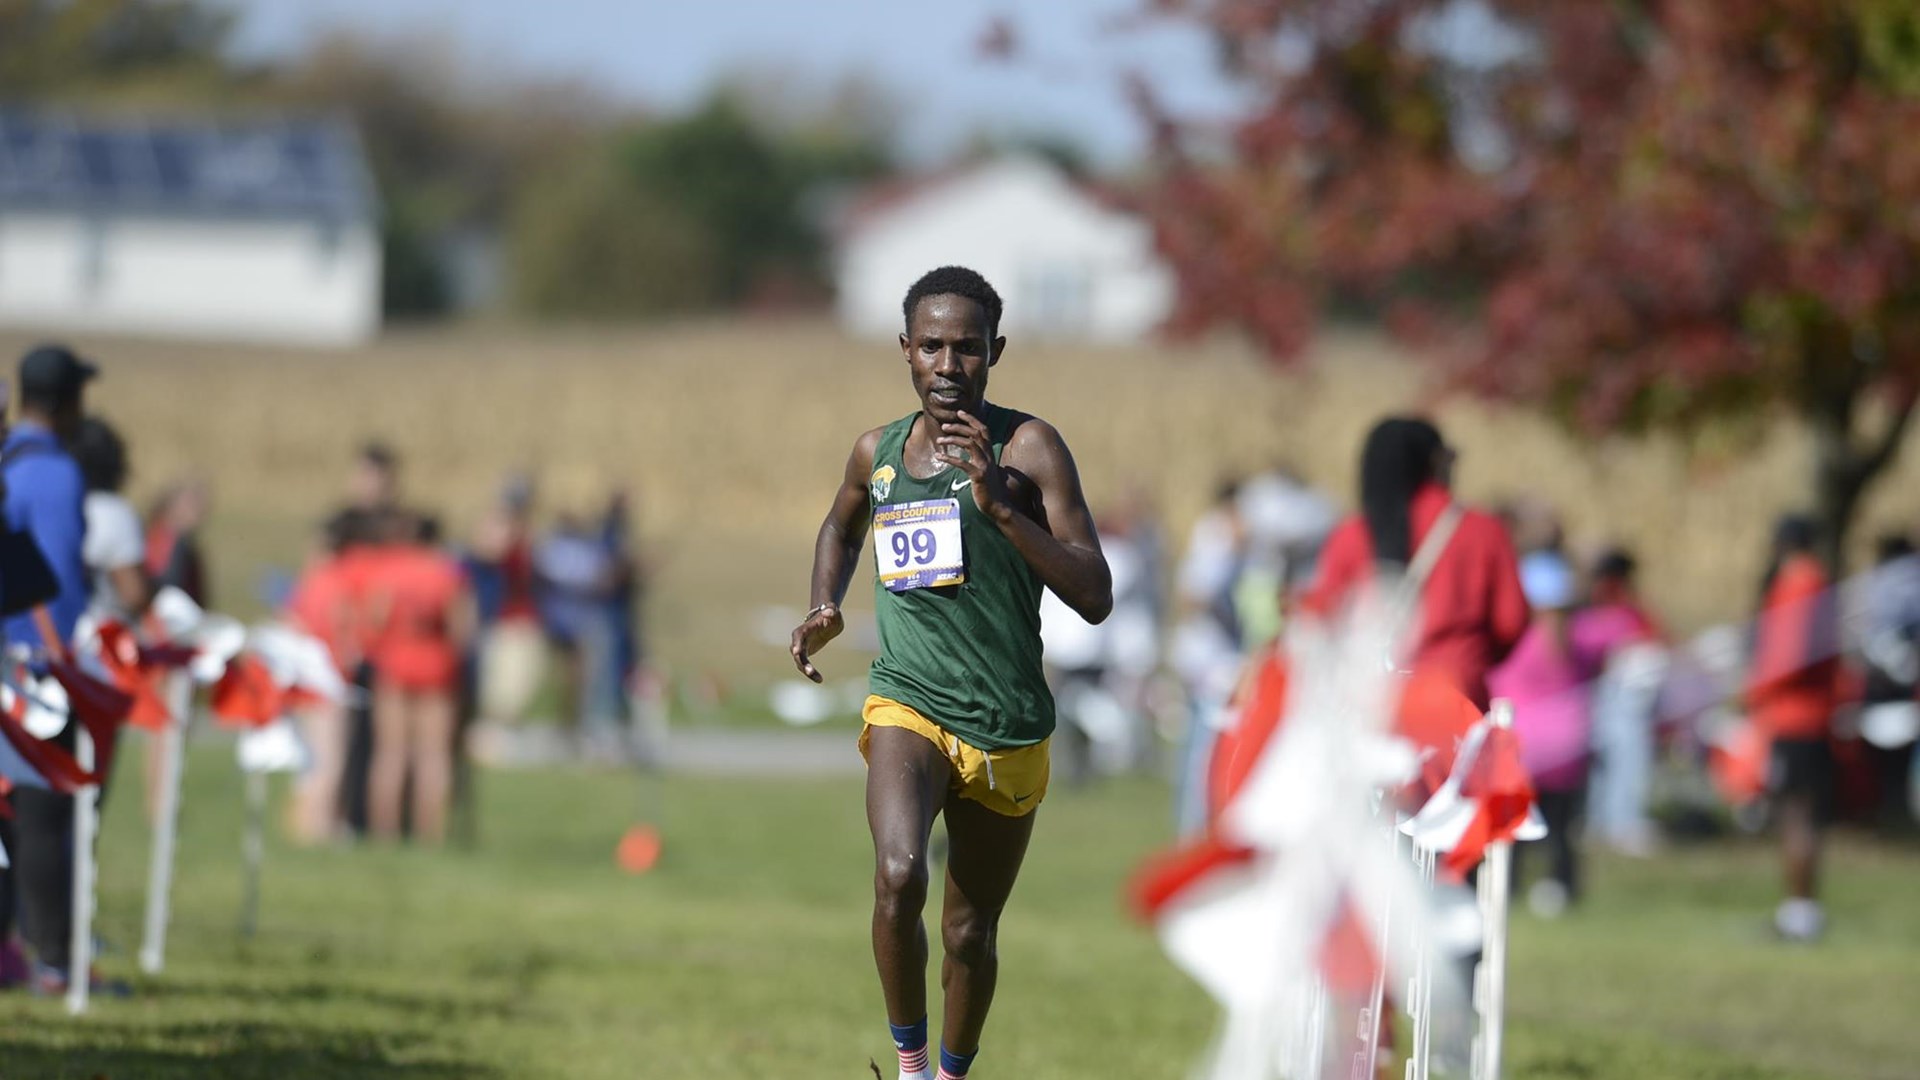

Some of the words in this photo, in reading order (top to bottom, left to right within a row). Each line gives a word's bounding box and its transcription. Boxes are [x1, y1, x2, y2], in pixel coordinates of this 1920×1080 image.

[875, 510, 902, 522] CROSS
[902, 505, 952, 518] COUNTRY
[891, 528, 937, 568] 99
